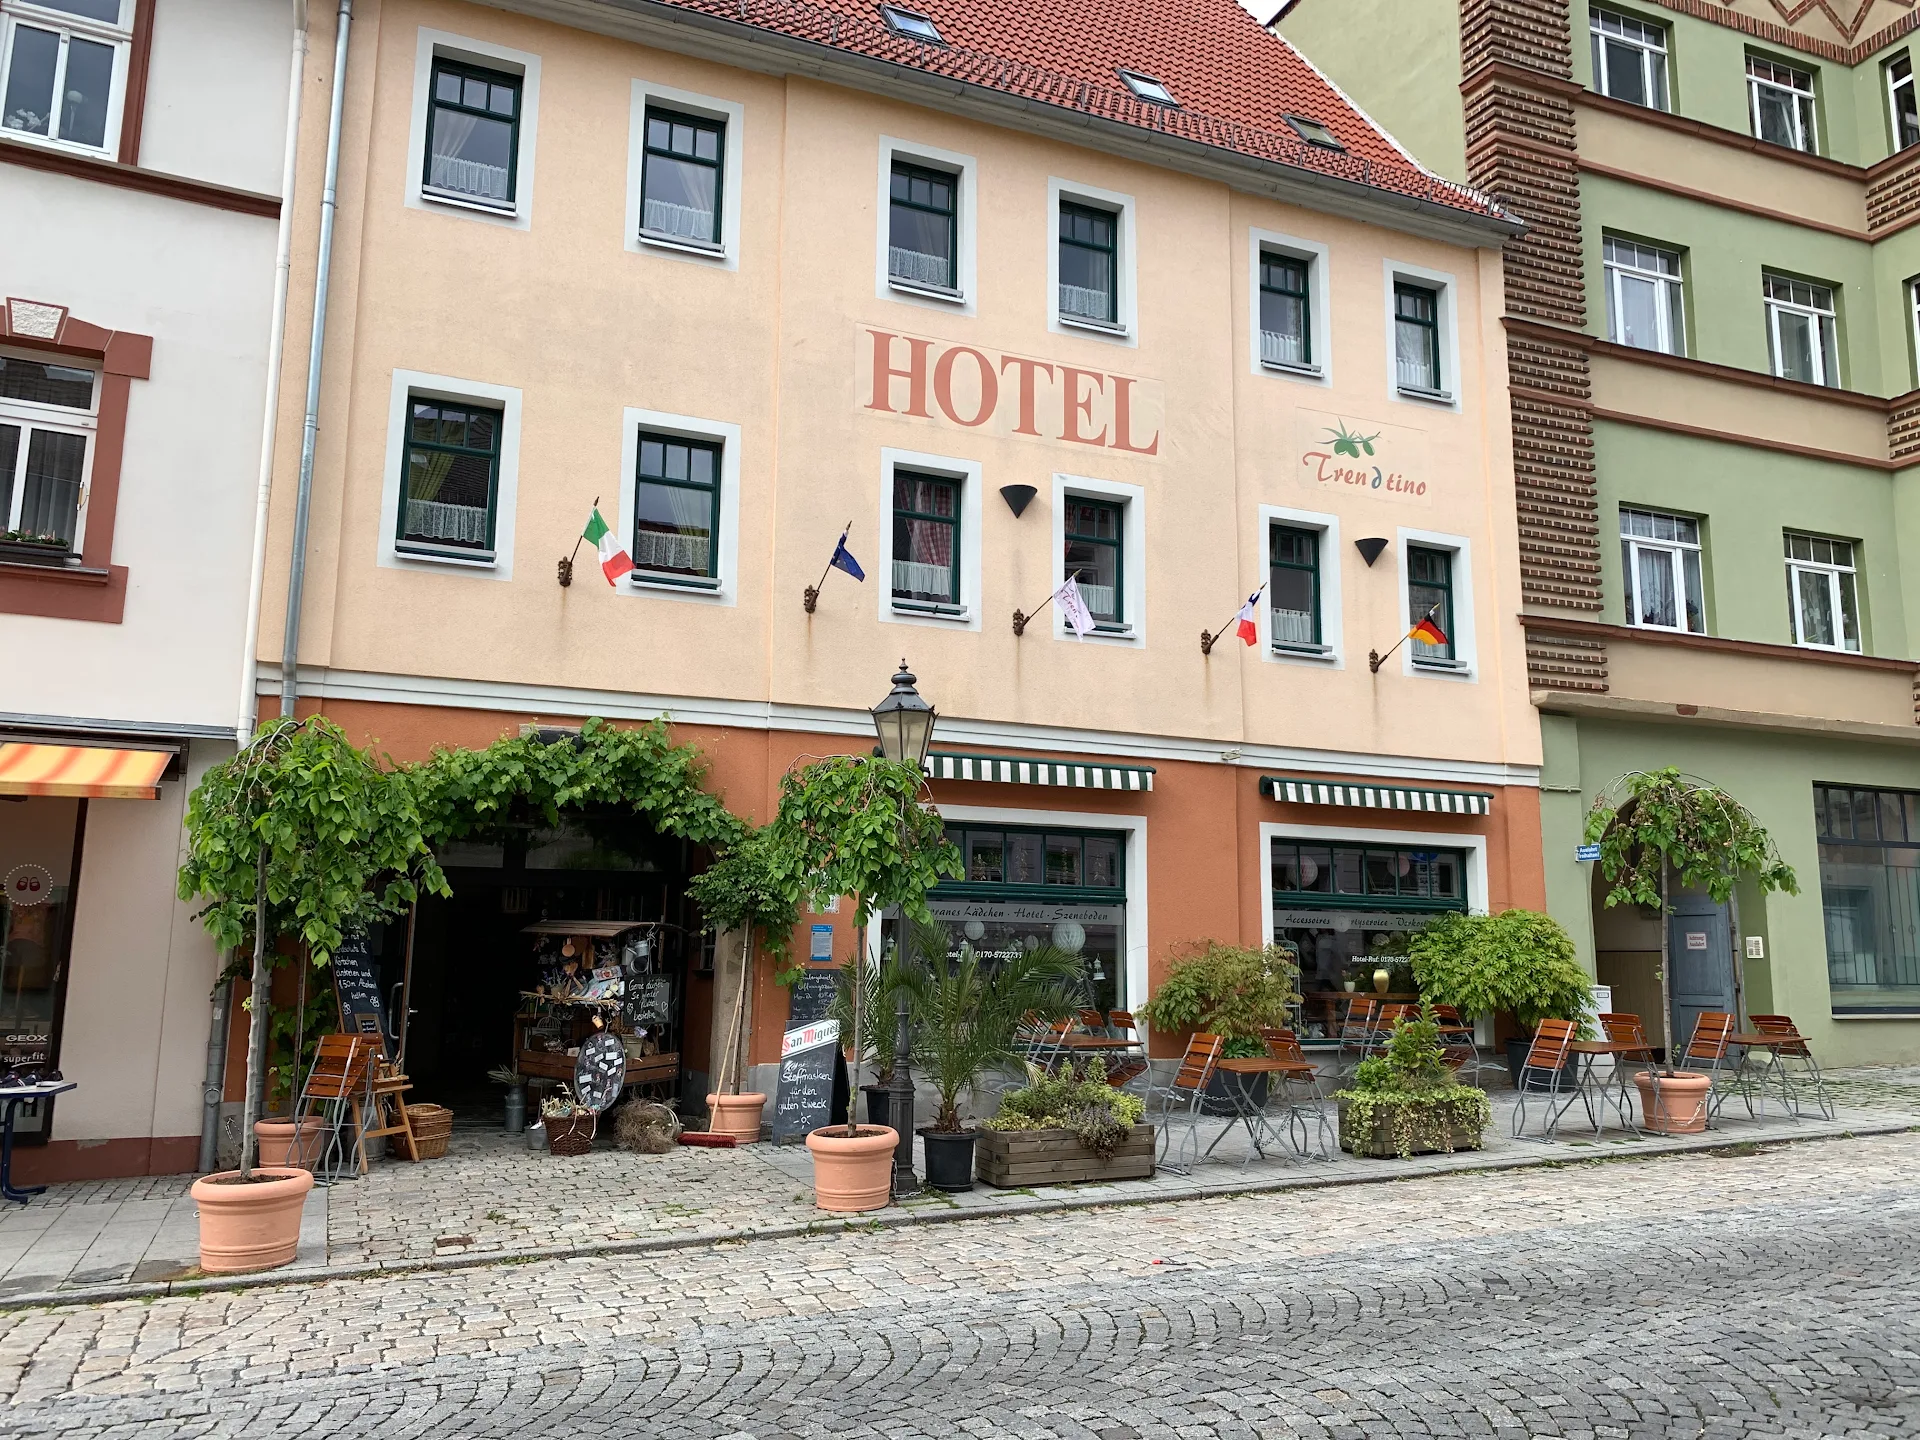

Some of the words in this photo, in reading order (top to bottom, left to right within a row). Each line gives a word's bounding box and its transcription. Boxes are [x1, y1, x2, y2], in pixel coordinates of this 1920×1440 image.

[864, 329, 1159, 456] HOTEL
[963, 905, 1004, 918] Lädchen
[1013, 907, 1044, 919] Hotel
[1052, 908, 1108, 921] Szeneboden
[1285, 913, 1330, 925] Accessoires
[5, 1034, 48, 1042] GEOX
[781, 1035, 802, 1053] San
[780, 1068, 832, 1085] Stoffmasken
[802, 1085, 818, 1096] den
[777, 1097, 799, 1116] guten
[801, 1098, 827, 1109] Zweck
